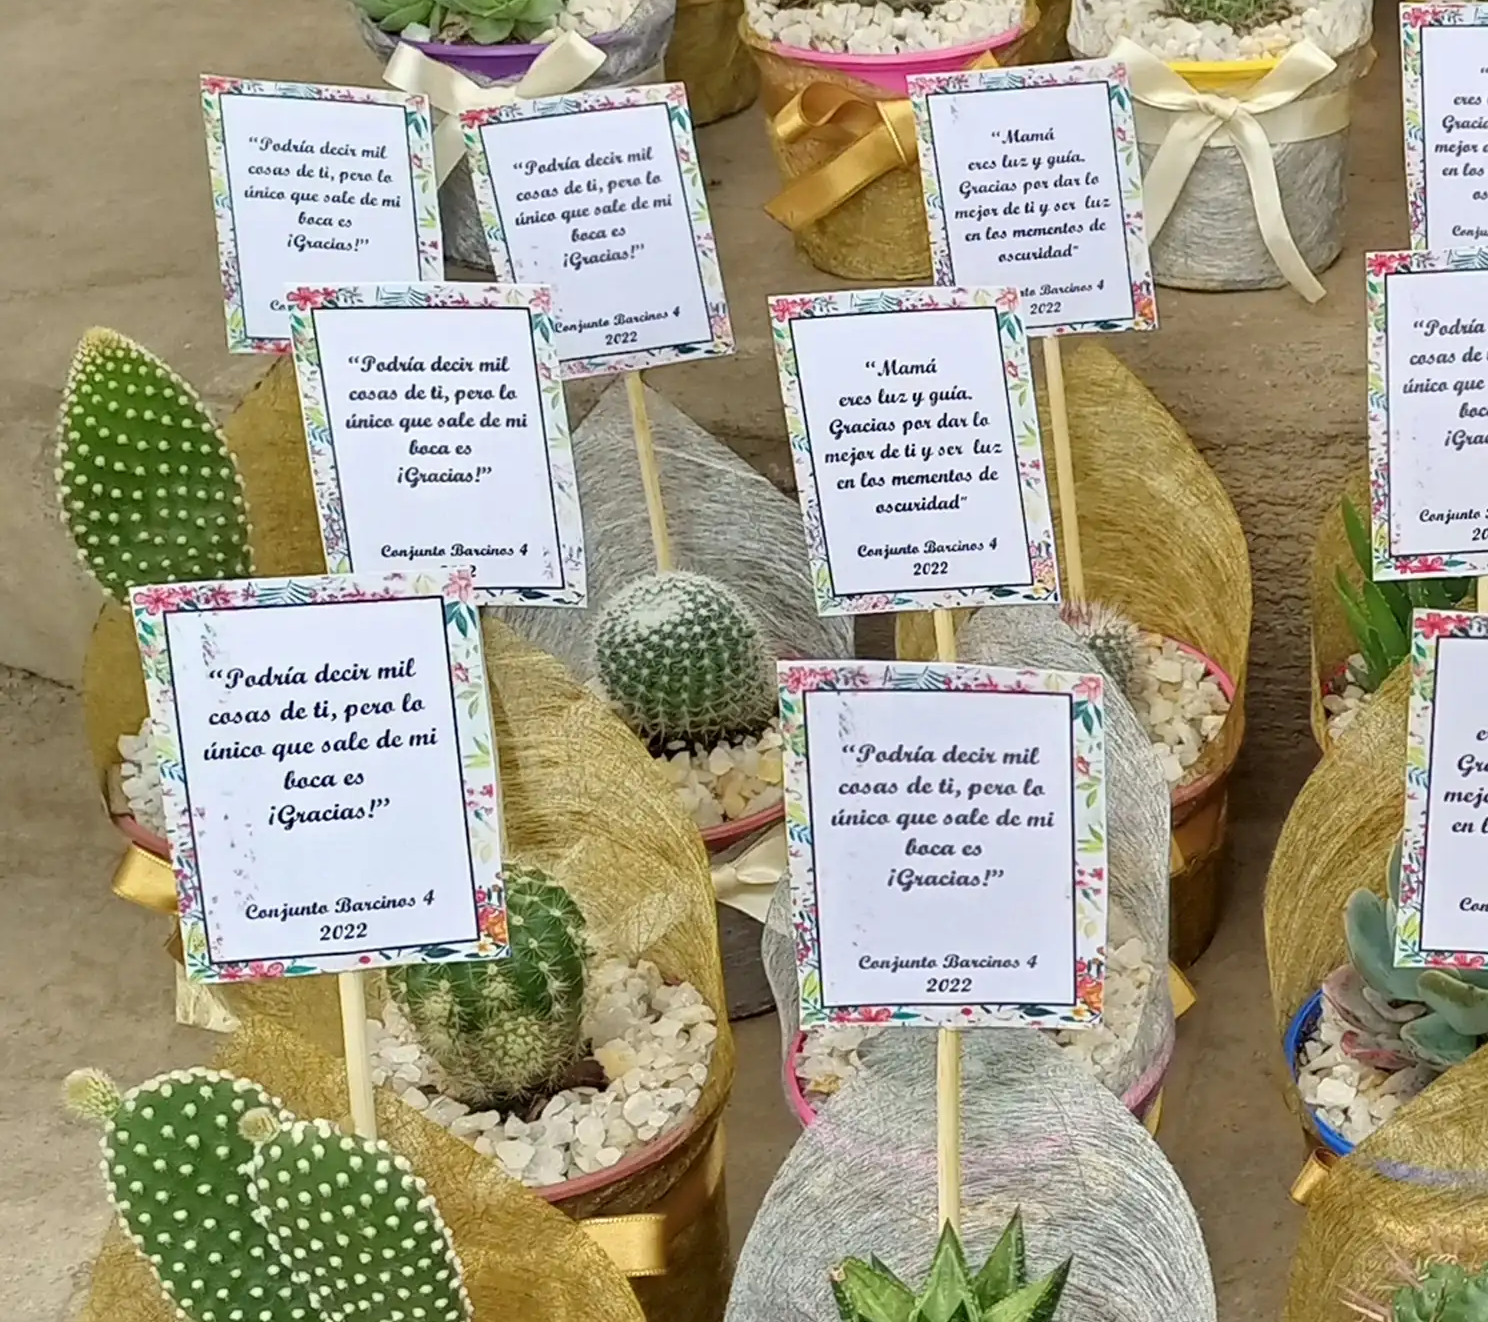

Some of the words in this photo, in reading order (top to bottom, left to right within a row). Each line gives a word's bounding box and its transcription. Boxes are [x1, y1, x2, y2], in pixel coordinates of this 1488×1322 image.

[838, 394, 872, 407] eres
[877, 387, 908, 405] luz
[911, 391, 925, 408] y
[828, 417, 896, 441] Gracias
[901, 419, 931, 436] por
[936, 411, 968, 429] dar
[972, 410, 989, 427] lo
[824, 446, 875, 467] mejor
[879, 442, 900, 460] de
[904, 442, 917, 458] ti
[920, 446, 933, 462] y
[937, 445, 963, 457] ser
[972, 438, 1002, 455] luz
[836, 478, 856, 490] en
[859, 471, 886, 488] los
[978, 464, 999, 482] de
[856, 543, 920, 560] Conjunto
[922, 539, 985, 554] Barcinos
[988, 536, 998, 550] 4
[912, 560, 949, 576] 2022
[314, 662, 371, 684] decir
[377, 656, 417, 680] mil
[208, 709, 271, 726] cosas
[279, 699, 308, 721] de
[312, 699, 338, 722] ti,
[343, 700, 395, 723] pero
[401, 692, 425, 713] lo
[203, 740, 266, 761] único
[271, 741, 315, 763] que
[320, 730, 370, 754] sale
[375, 728, 404, 749] de
[408, 727, 438, 747] mi
[283, 769, 337, 791] boca
[342, 772, 364, 786] es
[1451, 821, 1474, 834] en
[244, 901, 329, 922] Conjunto
[334, 894, 416, 914] Barcinos
[422, 888, 435, 906] 4
[319, 921, 368, 942] 2022
